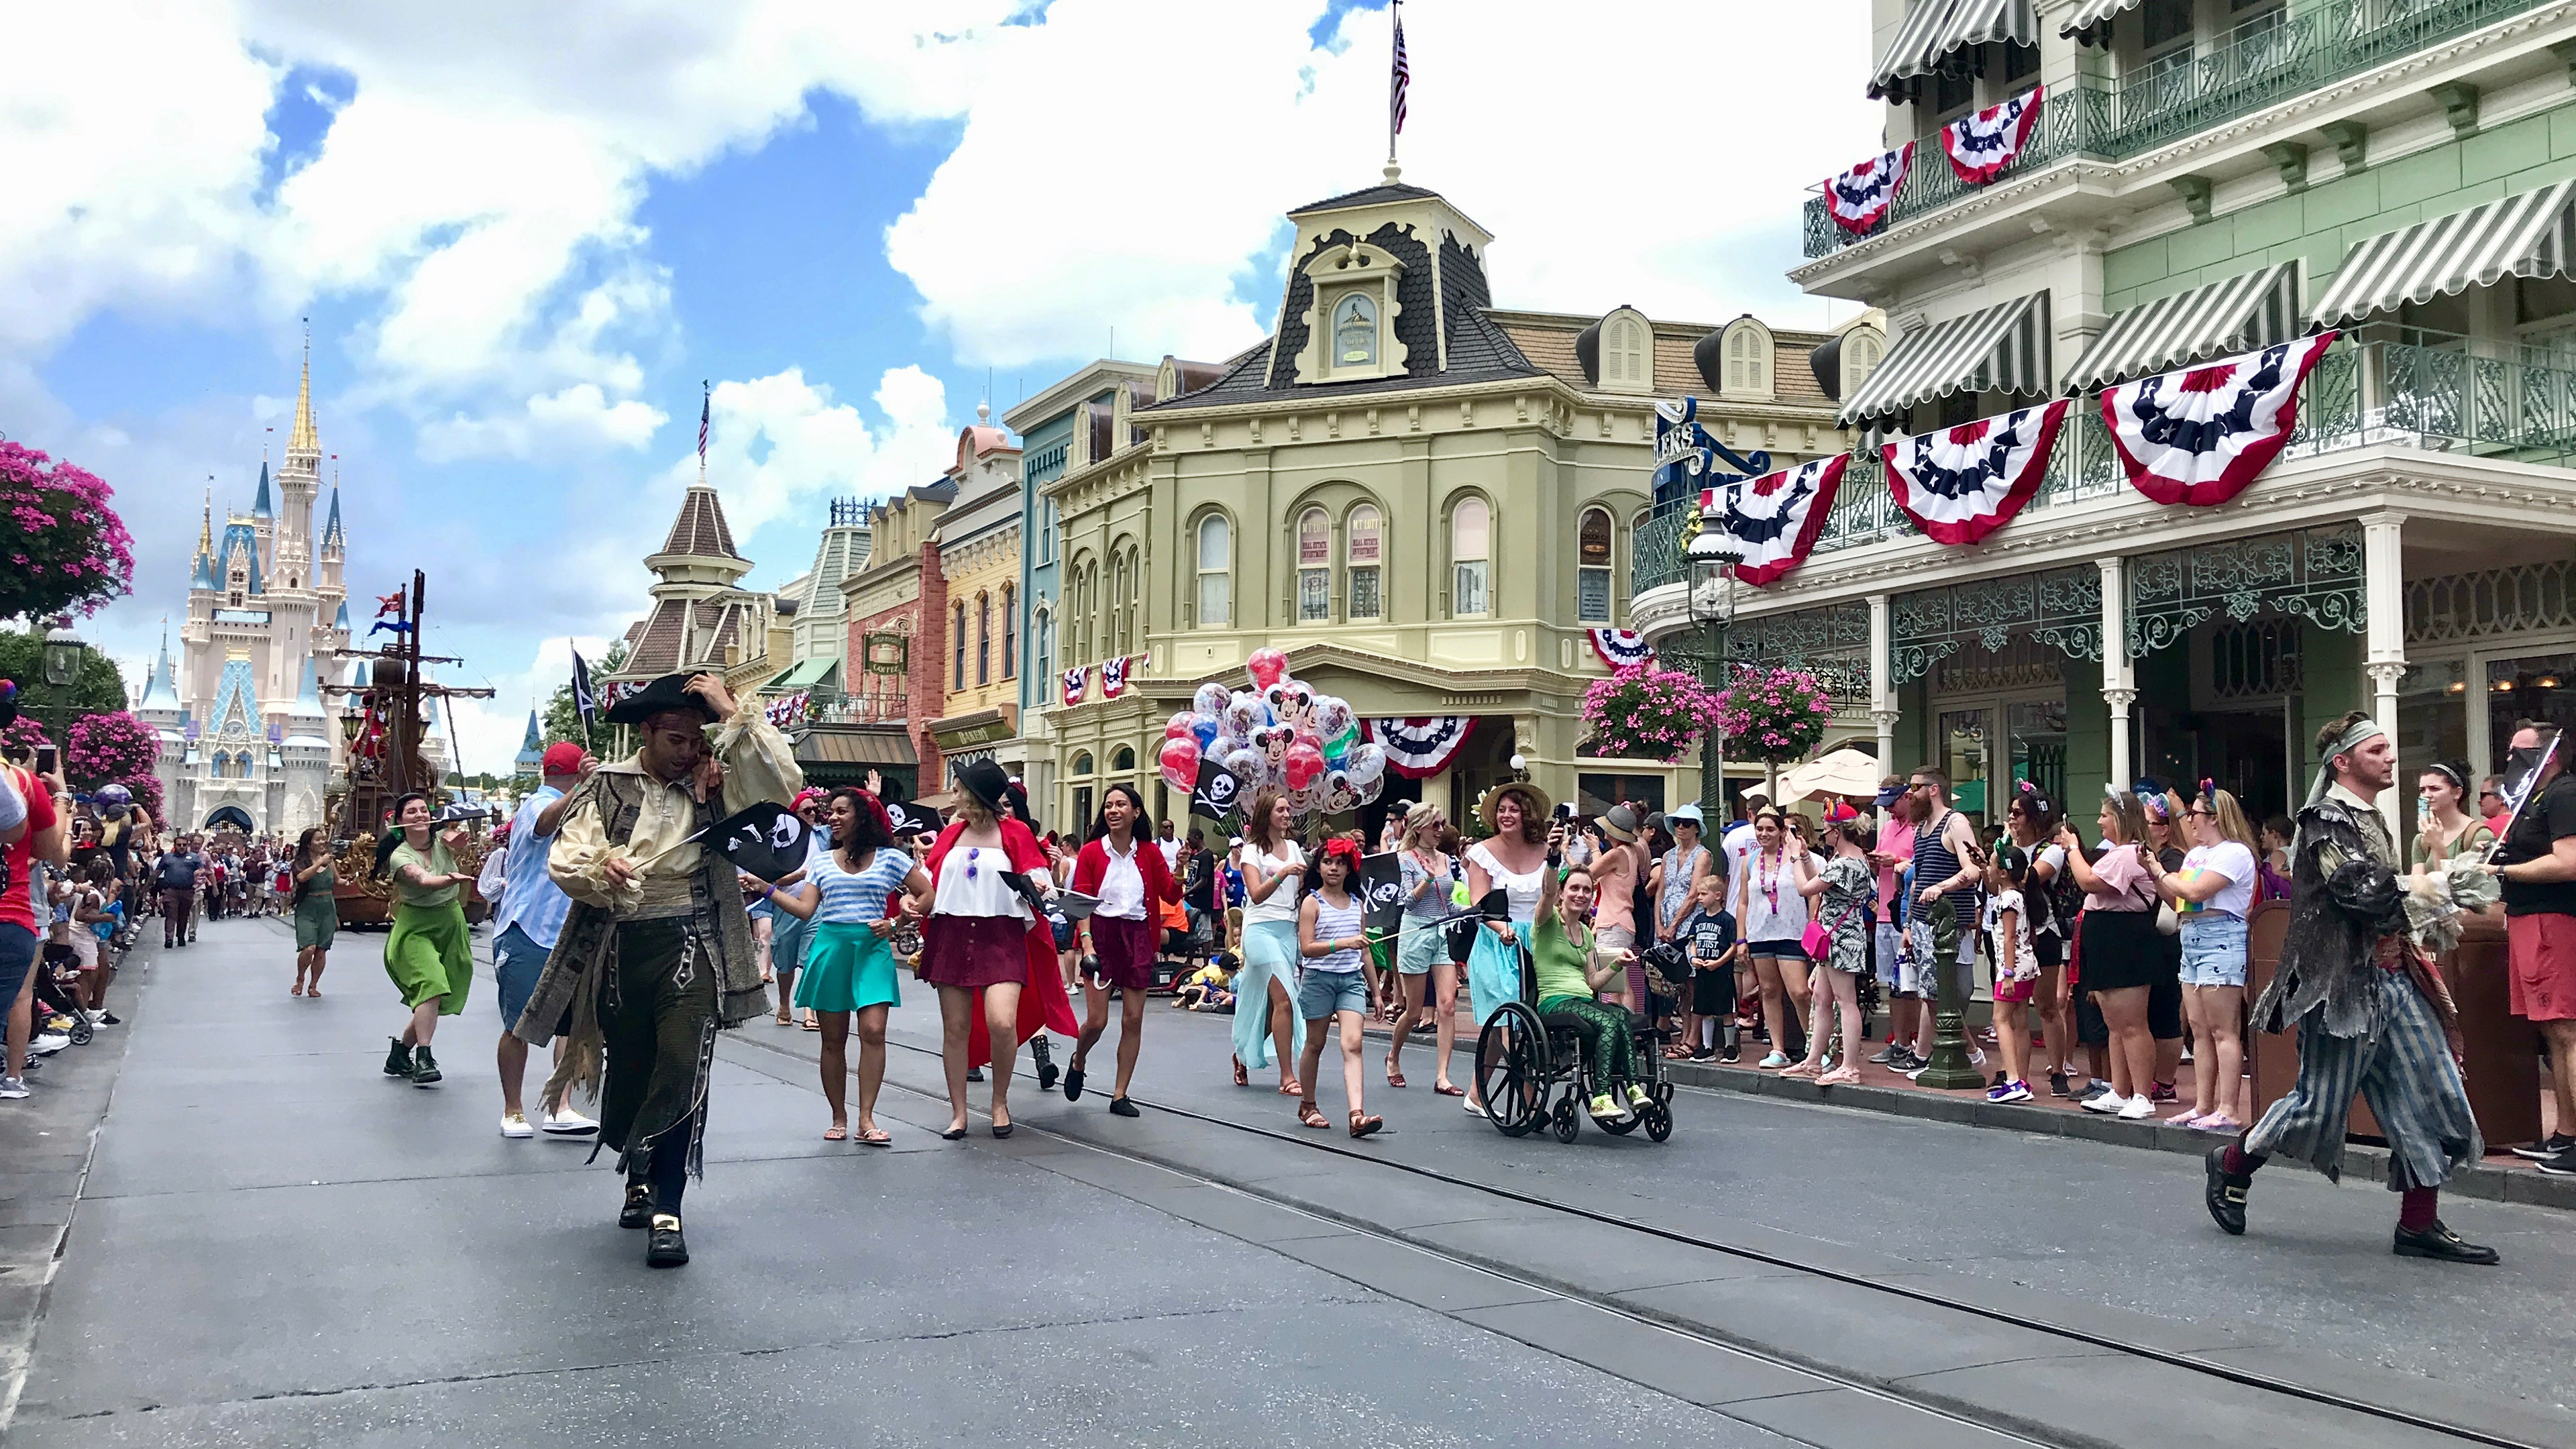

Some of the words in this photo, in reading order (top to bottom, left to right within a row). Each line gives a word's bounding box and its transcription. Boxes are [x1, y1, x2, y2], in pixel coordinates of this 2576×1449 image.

[1654, 421, 1694, 465] LERS
[873, 663, 902, 674] COFFEE
[957, 727, 989, 745] BAKERY
[1702, 940, 1719, 949] JUST
[1706, 949, 1709, 957] I
[1711, 949, 1719, 958] DO
